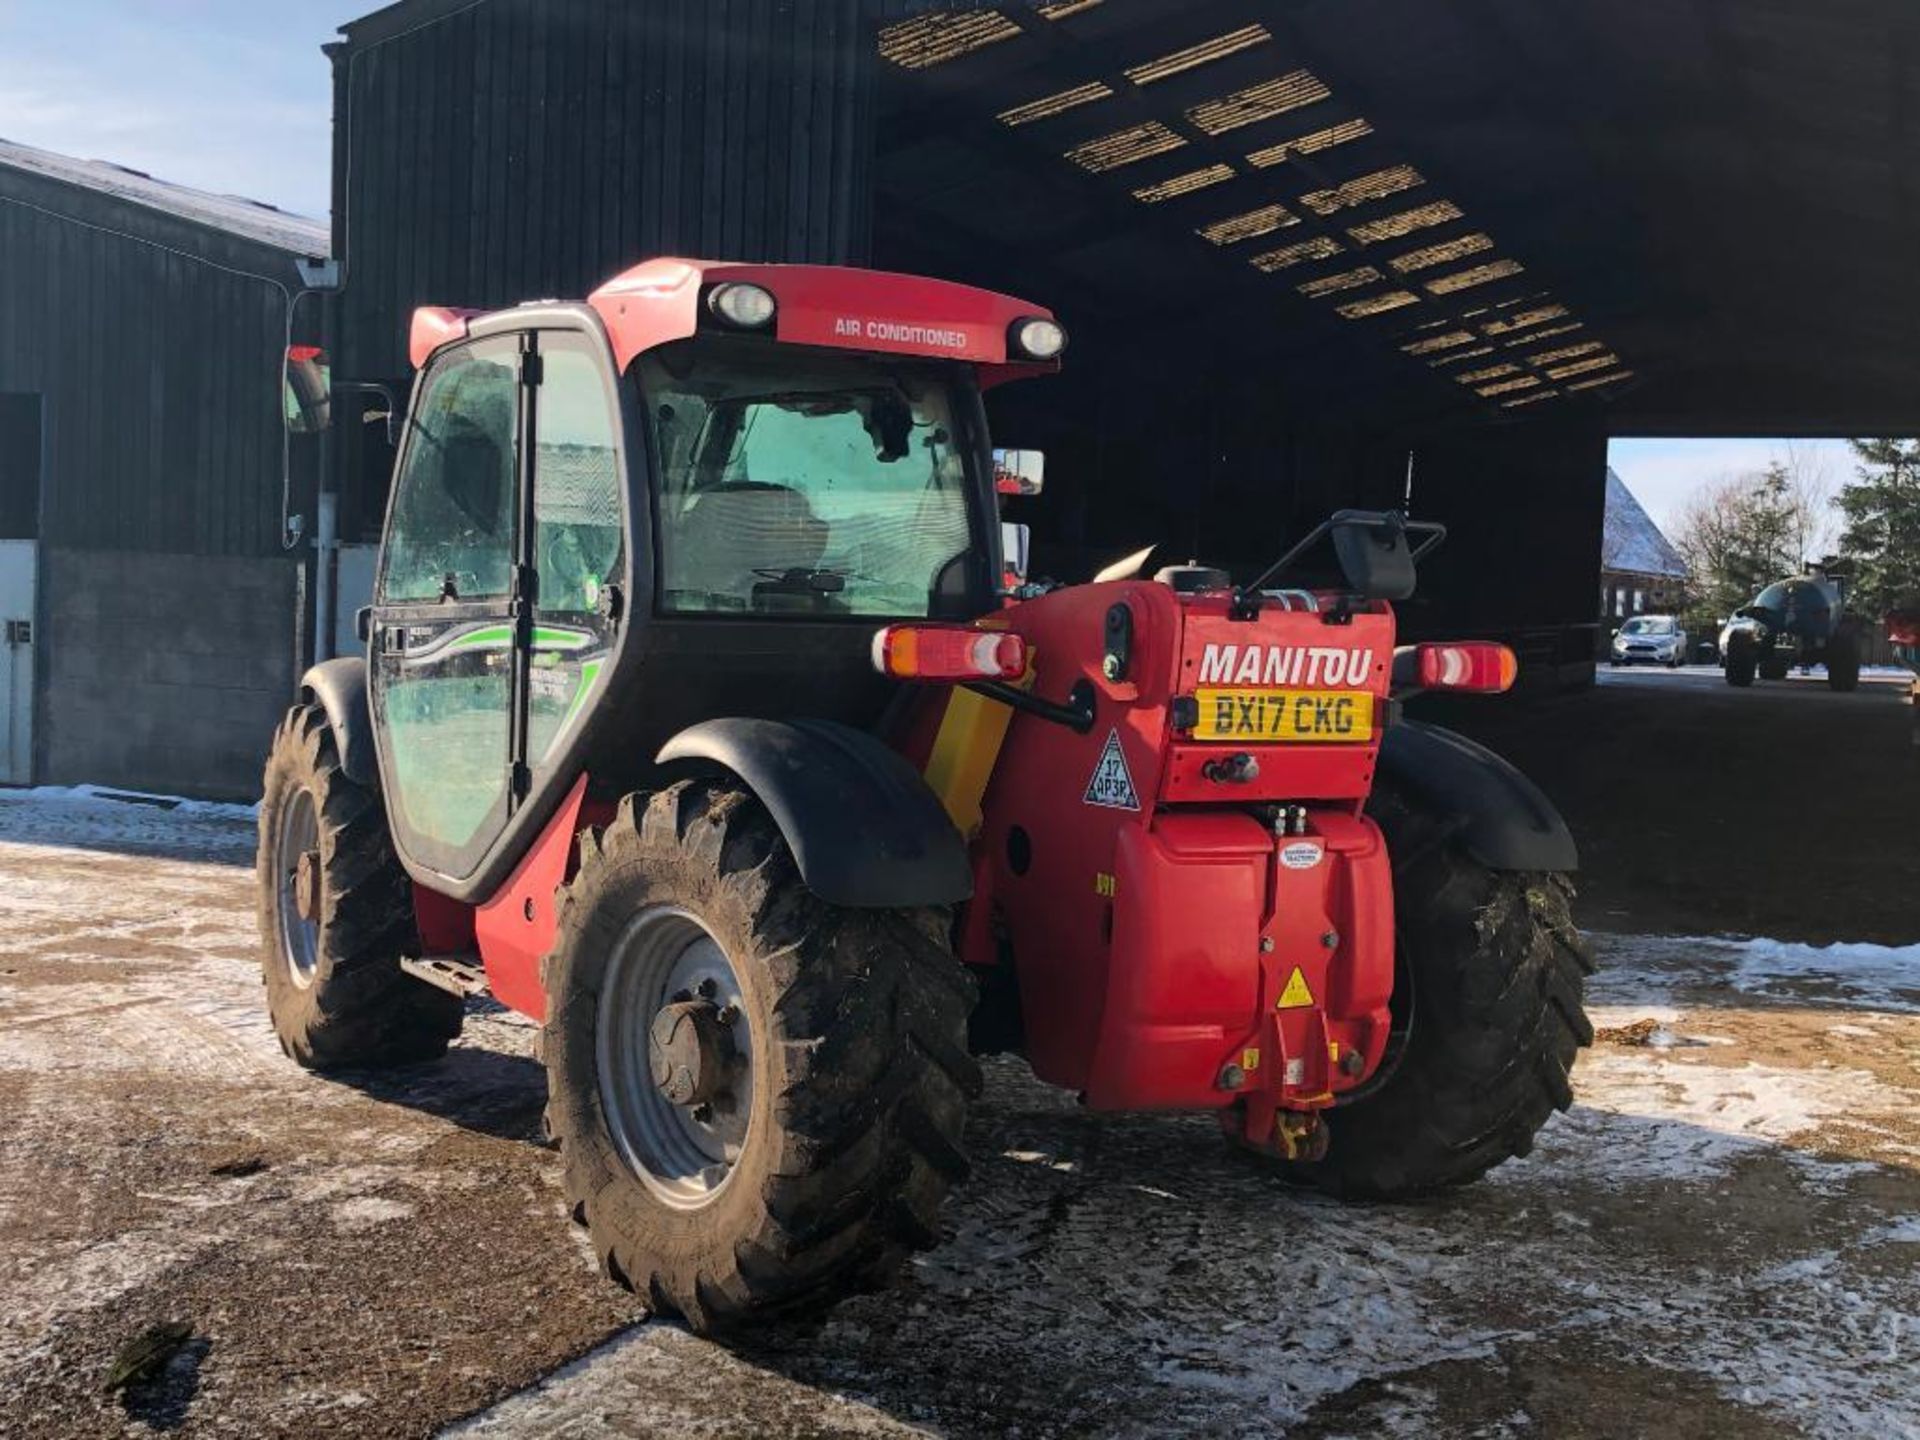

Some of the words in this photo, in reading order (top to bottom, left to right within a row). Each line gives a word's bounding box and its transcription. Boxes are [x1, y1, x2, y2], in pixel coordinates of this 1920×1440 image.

[835, 318, 861, 336] AIR
[867, 321, 966, 348] CONDITIONED
[1199, 644, 1372, 686] MANITOU
[1215, 696, 1286, 734] BX17
[1294, 697, 1353, 734] CKG
[1105, 758, 1120, 777] 17
